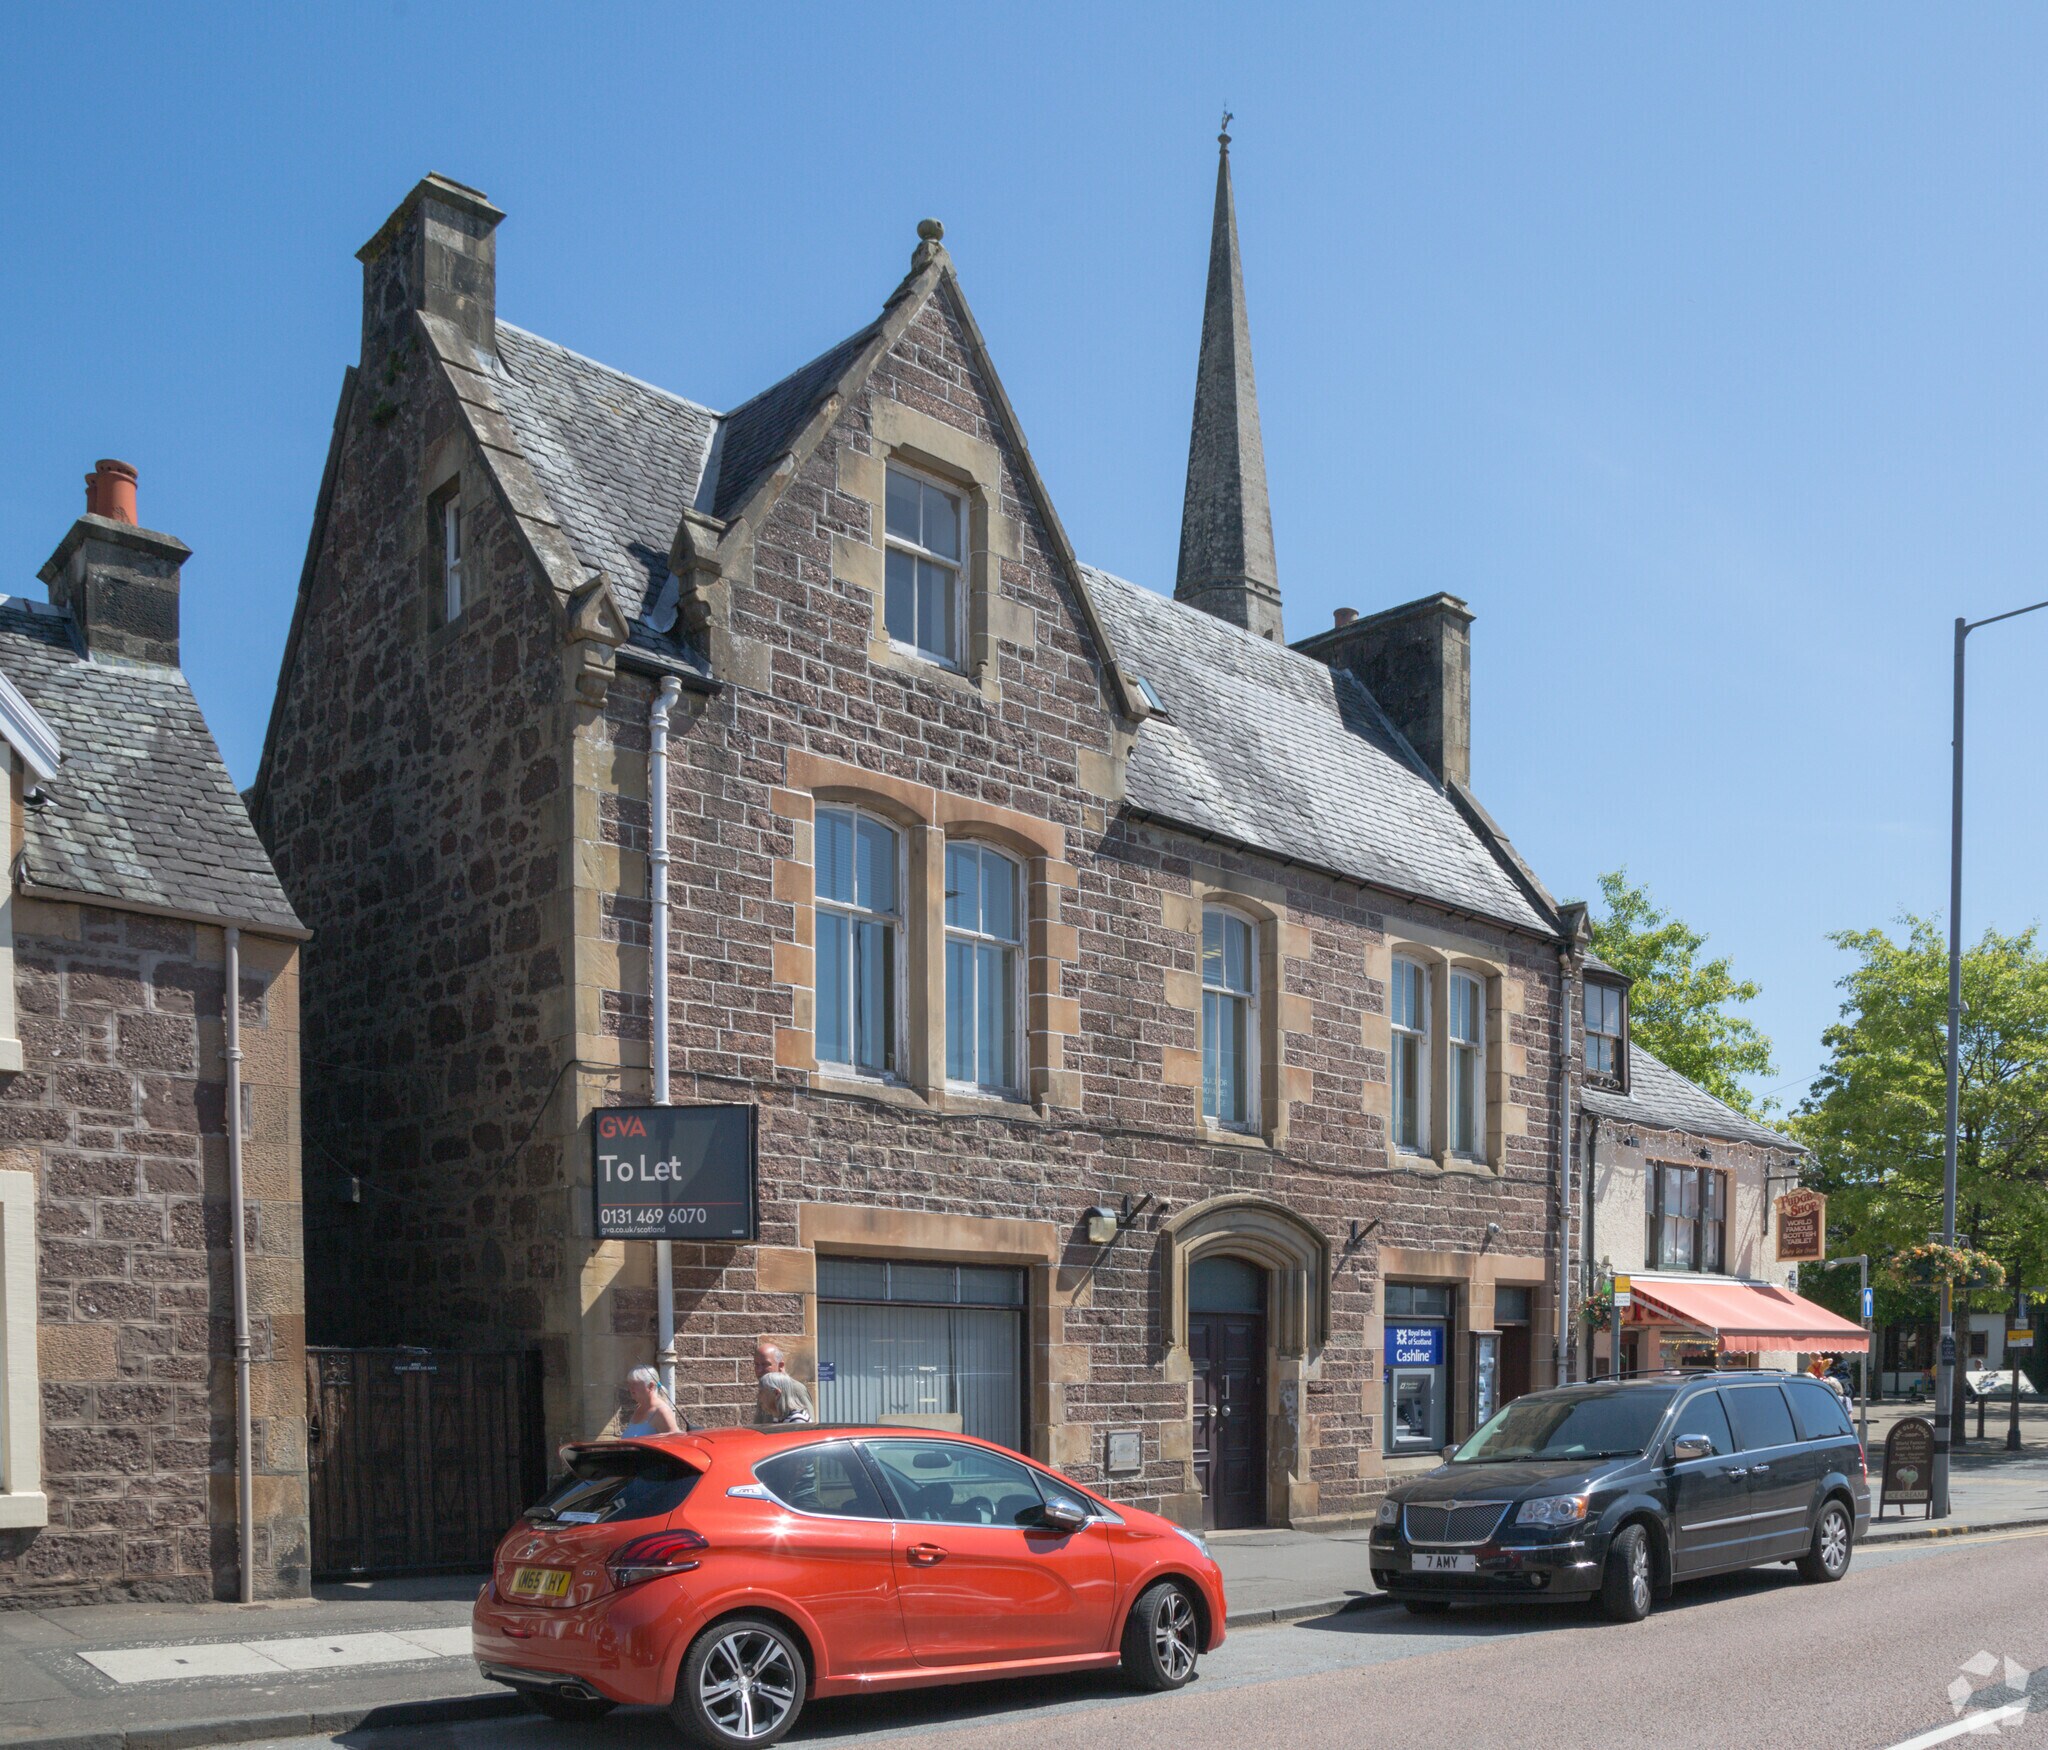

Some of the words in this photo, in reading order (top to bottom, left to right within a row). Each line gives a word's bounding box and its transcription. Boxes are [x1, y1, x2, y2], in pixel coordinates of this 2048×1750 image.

[599, 1116, 647, 1139] GVA
[599, 1155, 634, 1182] To
[640, 1154, 682, 1181] Let
[1781, 1192, 1813, 1209] FUDGE
[1791, 1201, 1817, 1216] SHOP
[601, 1208, 632, 1224] 0131
[636, 1208, 663, 1224] 469
[668, 1208, 707, 1224] 6070
[601, 1226, 666, 1235] gva.co.uk/scotland
[1783, 1231, 1816, 1239] SCOTTISH
[1408, 1329, 1420, 1338] Royal
[1420, 1329, 1432, 1337] Bank
[1396, 1349, 1430, 1362] Cashline
[1902, 1423, 1914, 1431] OLD
[1887, 1491, 1898, 1499] ICE
[1426, 1555, 1433, 1568] 7
[1436, 1556, 1458, 1568] AMY
